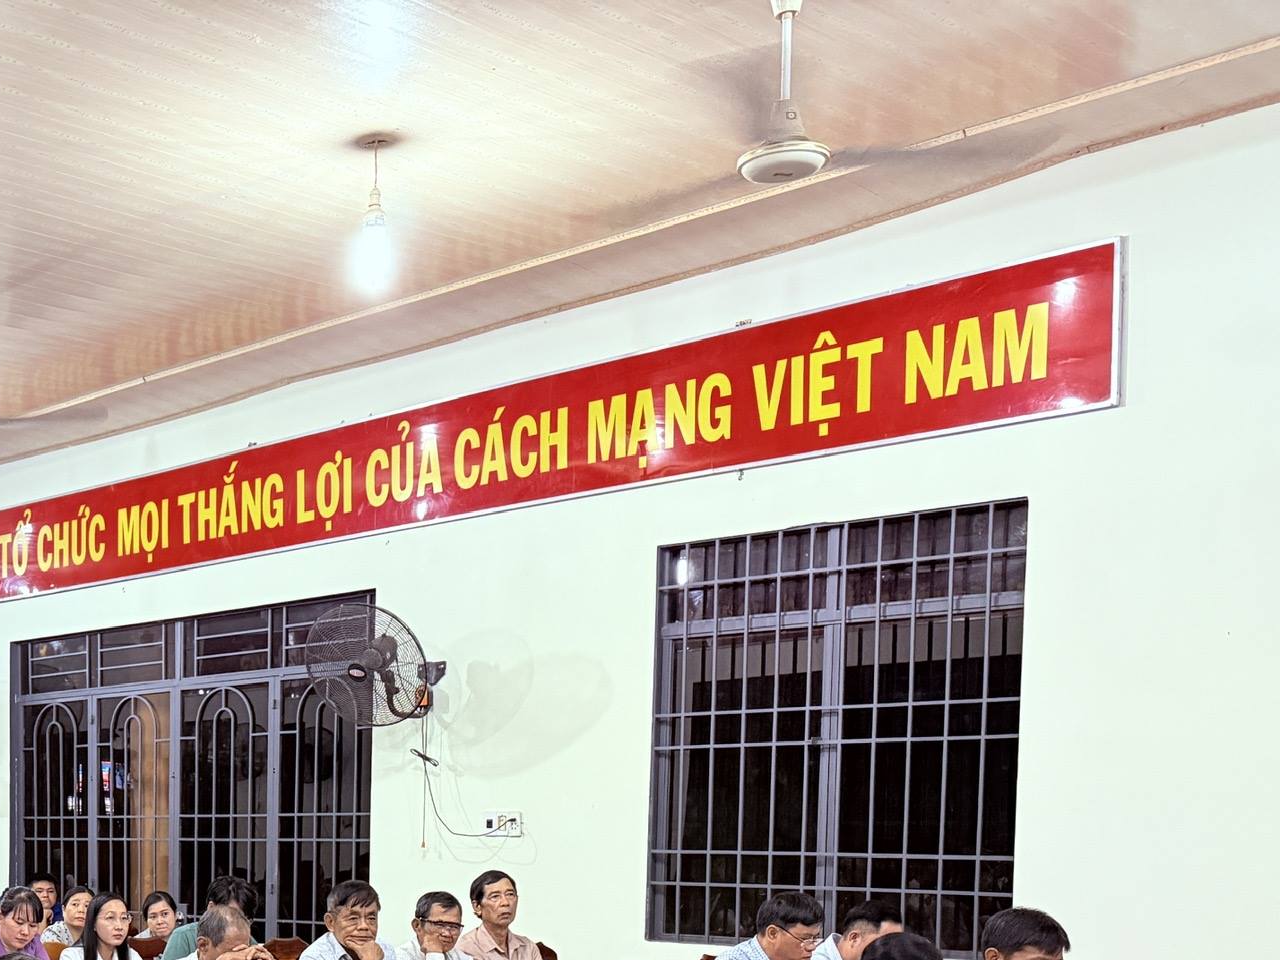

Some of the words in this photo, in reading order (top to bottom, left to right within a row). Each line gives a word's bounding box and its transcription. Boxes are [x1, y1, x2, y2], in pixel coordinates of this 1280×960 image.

[37, 504, 106, 572] CHỨC
[117, 498, 169, 564] MỌI
[177, 461, 284, 545] THẮNG
[297, 450, 352, 532] LỢI
[365, 420, 443, 508] CỦA
[453, 406, 569, 490] CÁCH
[587, 372, 732, 469] MẠNG
[753, 330, 884, 437] VIỆT
[904, 302, 1049, 405] NAM
